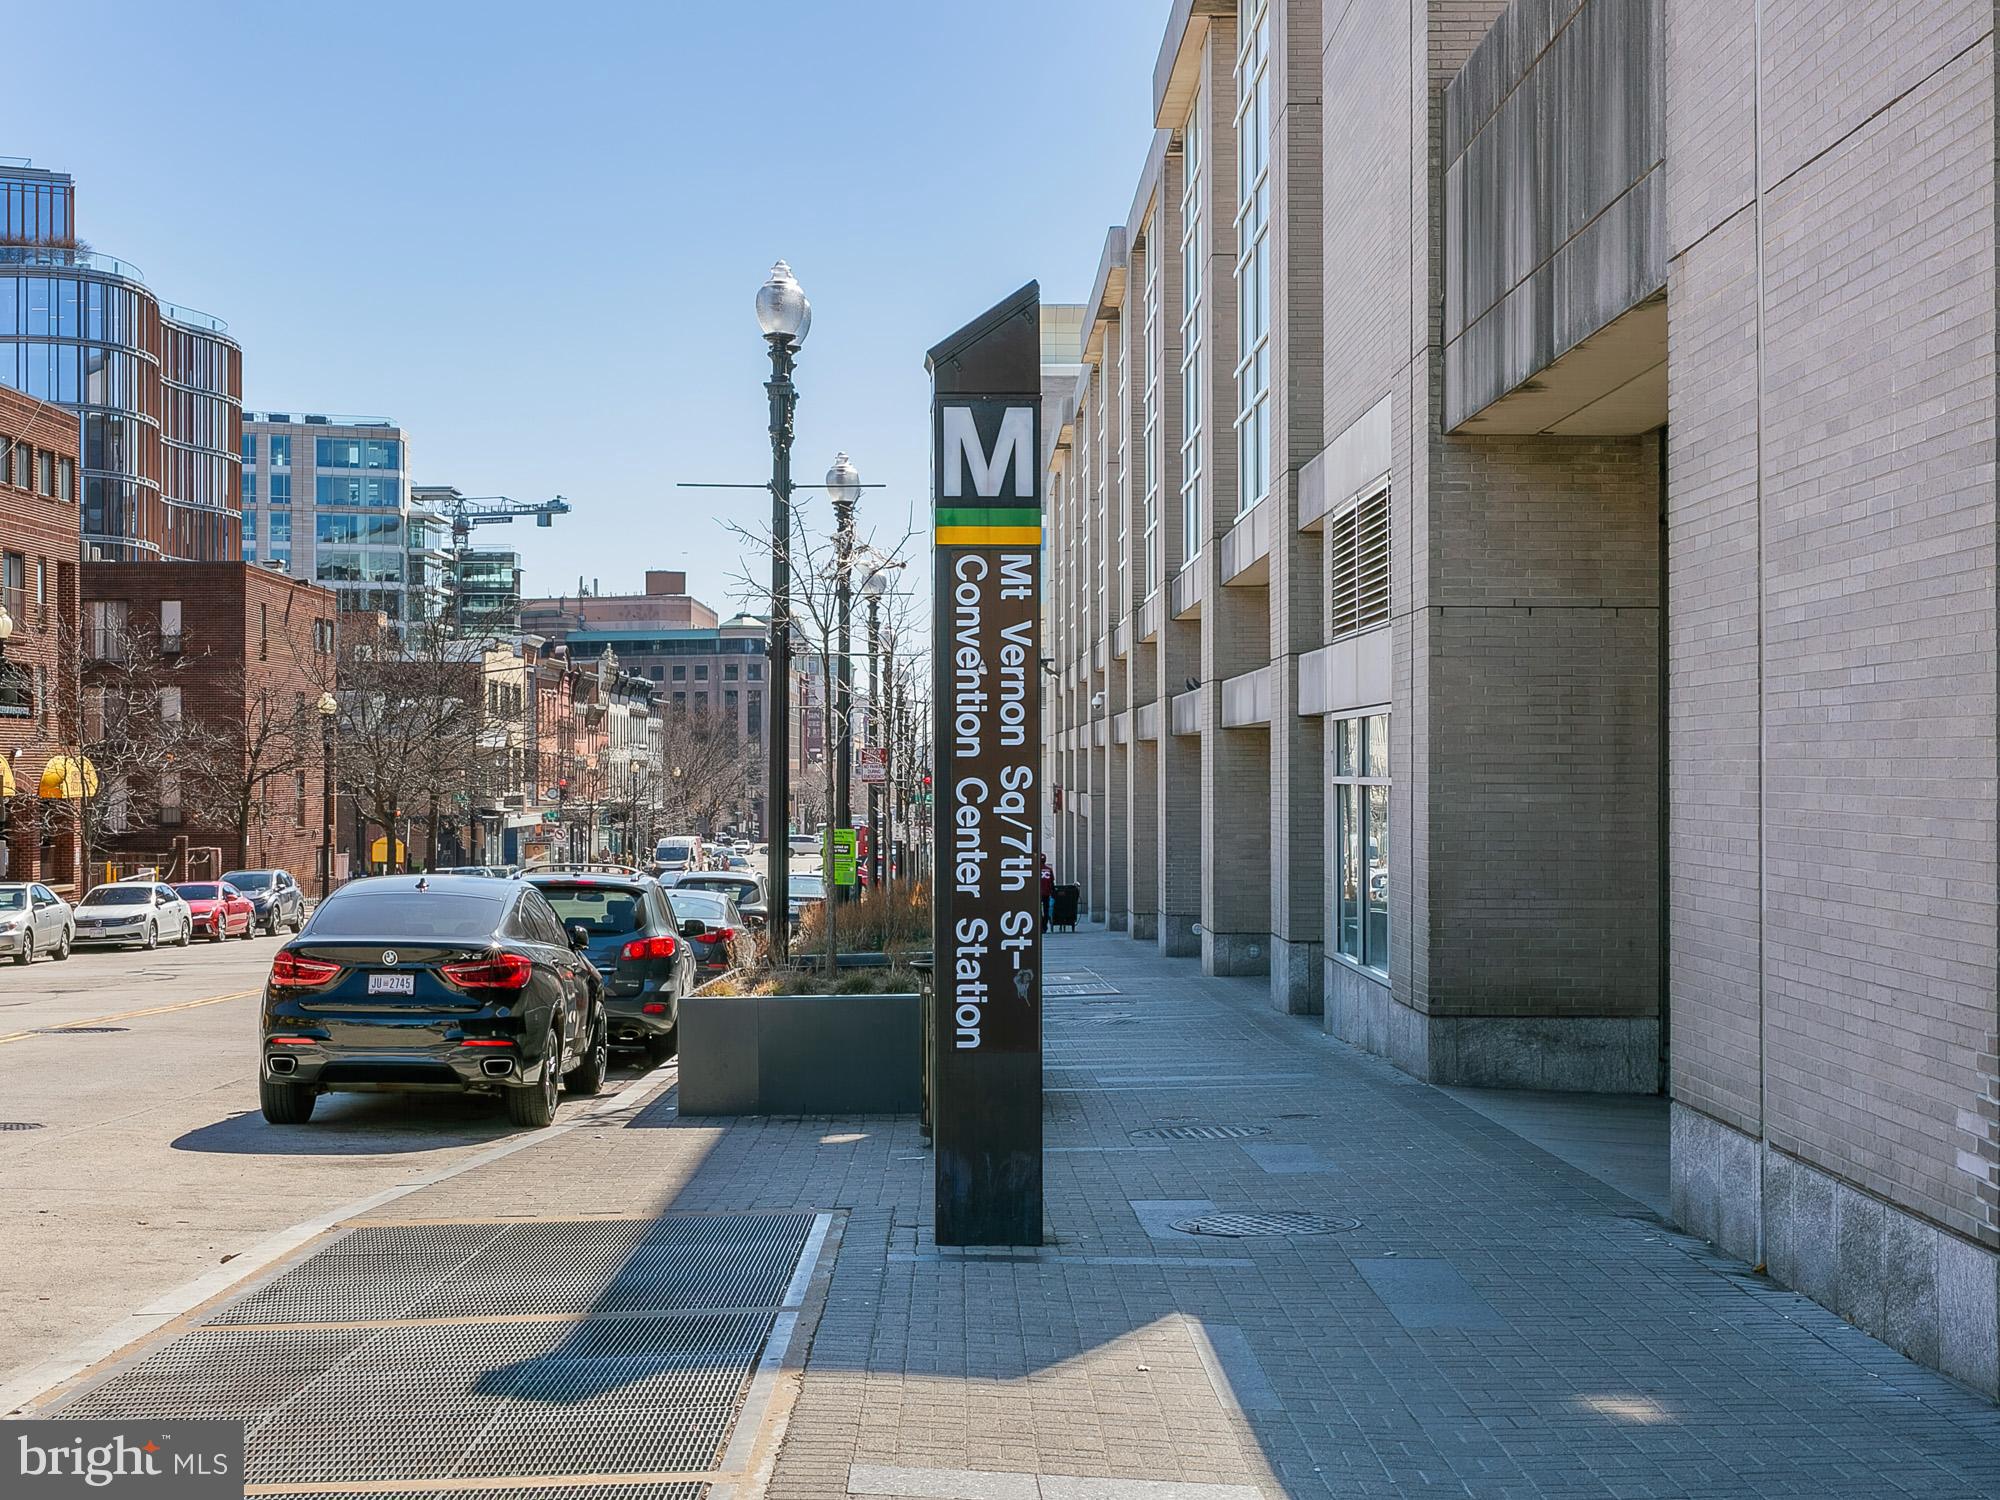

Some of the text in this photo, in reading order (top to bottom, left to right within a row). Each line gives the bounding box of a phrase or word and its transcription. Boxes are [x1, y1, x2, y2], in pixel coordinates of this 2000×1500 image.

[943, 406, 1034, 497] M
[1000, 554, 1033, 600] Mt
[1000, 619, 1033, 746] Vernon
[955, 554, 989, 1049] Convention Center Station
[993, 765, 1033, 891] Sq/7th
[371, 977, 411, 989] JU 2745
